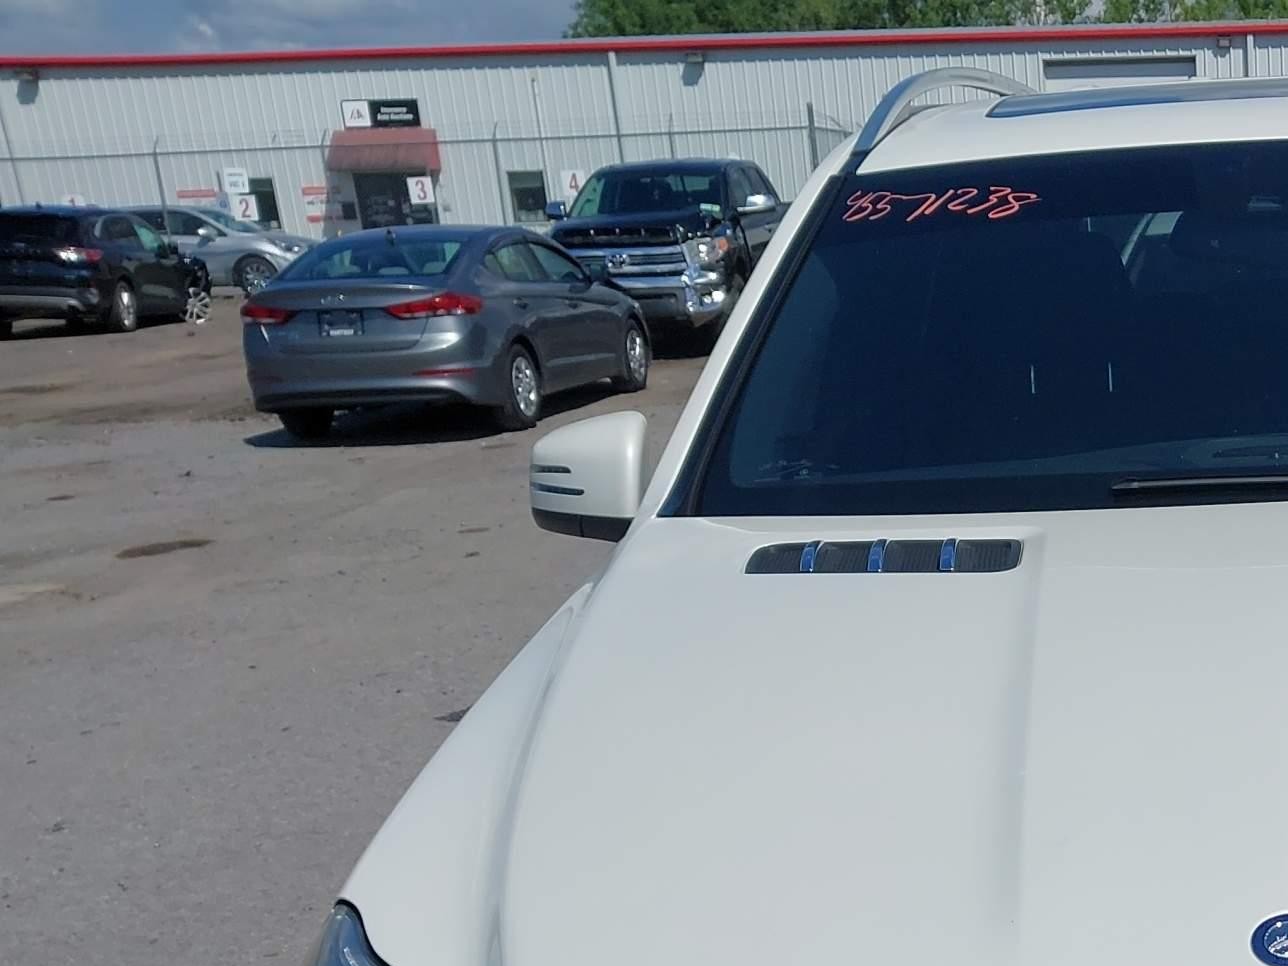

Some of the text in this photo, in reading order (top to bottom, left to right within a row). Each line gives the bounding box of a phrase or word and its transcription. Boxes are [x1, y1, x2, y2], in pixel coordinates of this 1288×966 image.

[415, 179, 427, 201] 3
[569, 172, 579, 192] 4
[239, 198, 251, 218] 2
